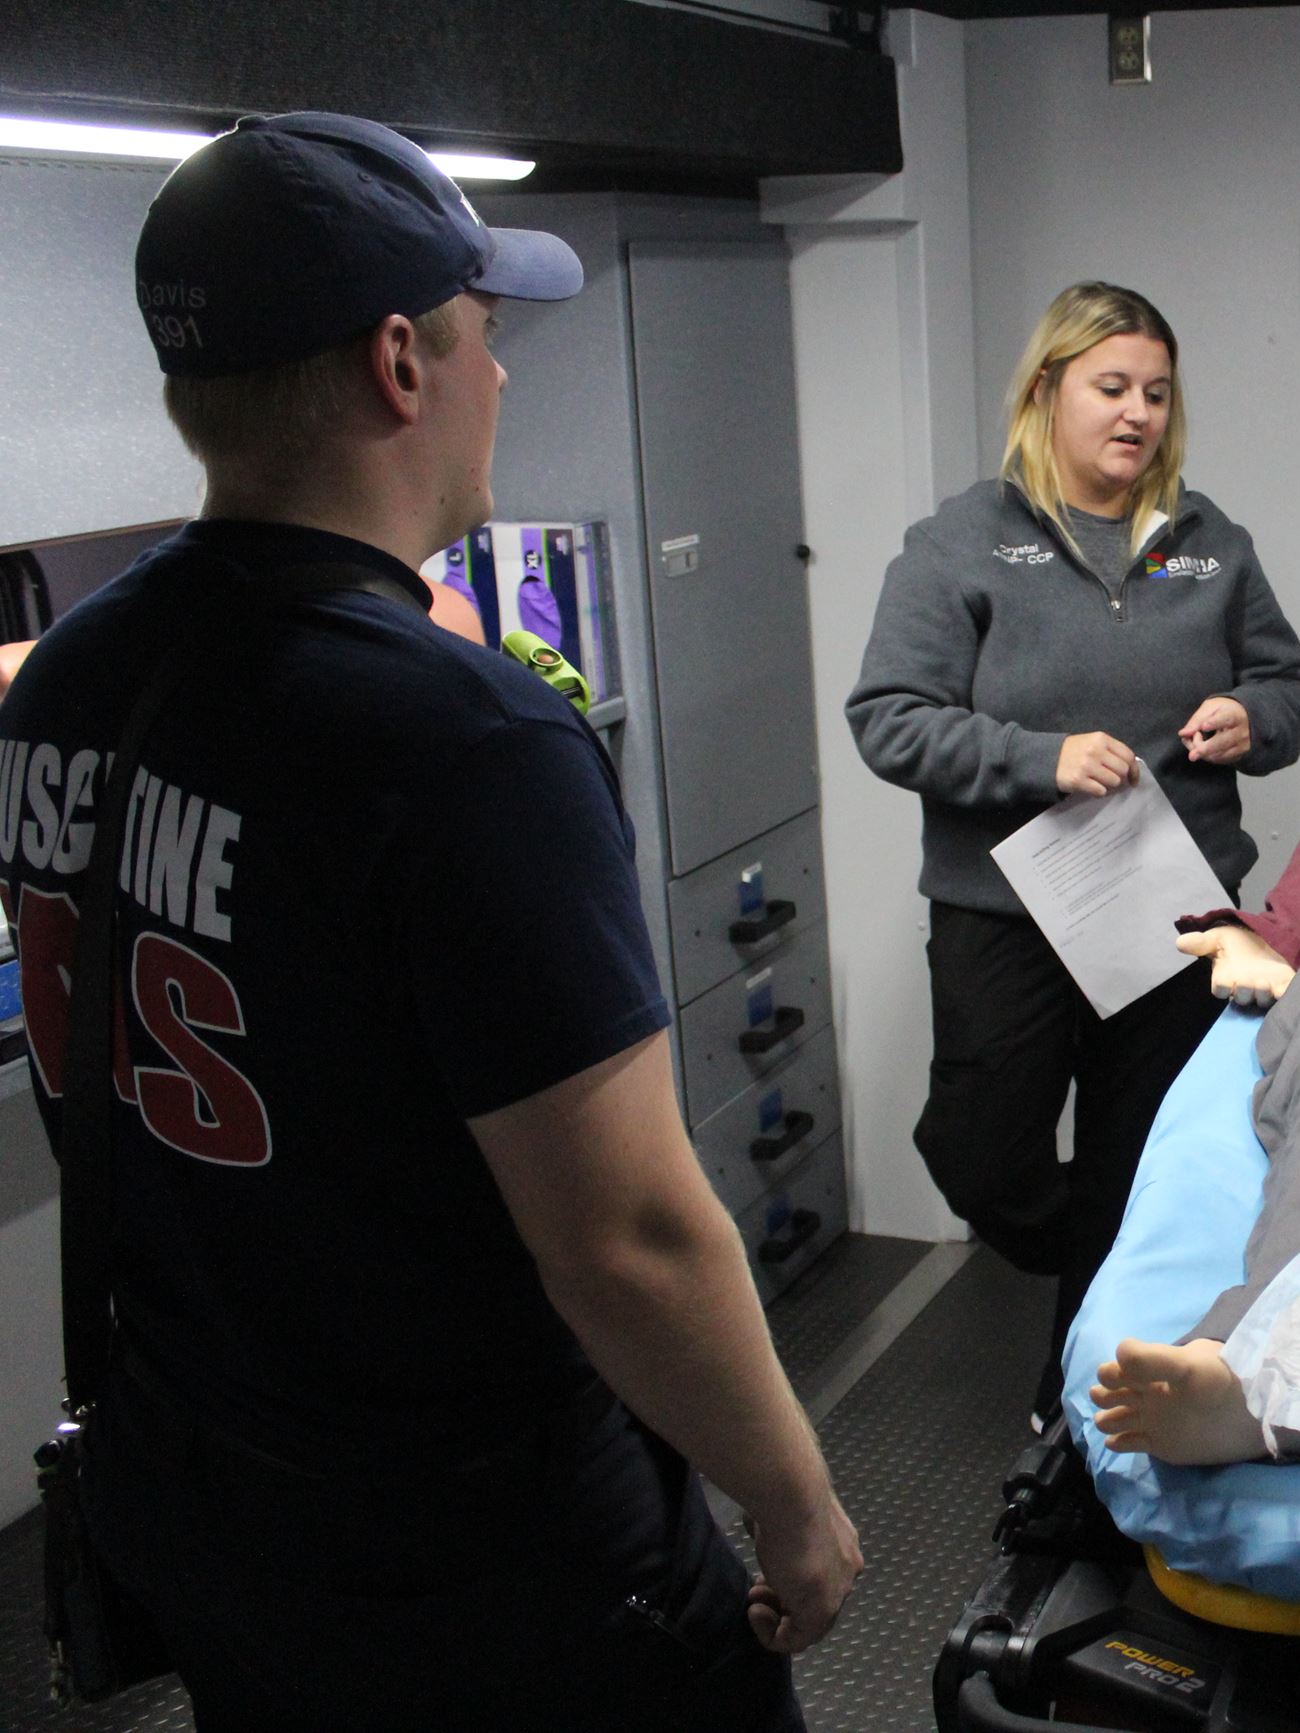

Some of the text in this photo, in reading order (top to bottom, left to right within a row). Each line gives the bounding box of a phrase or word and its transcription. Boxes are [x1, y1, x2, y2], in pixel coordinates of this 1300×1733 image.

[139, 279, 206, 309] Davis
[153, 314, 204, 349] 391
[1027, 551, 1054, 564] CCP
[0, 737, 242, 943] USCTINE
[1104, 1641, 1195, 1678] POWER
